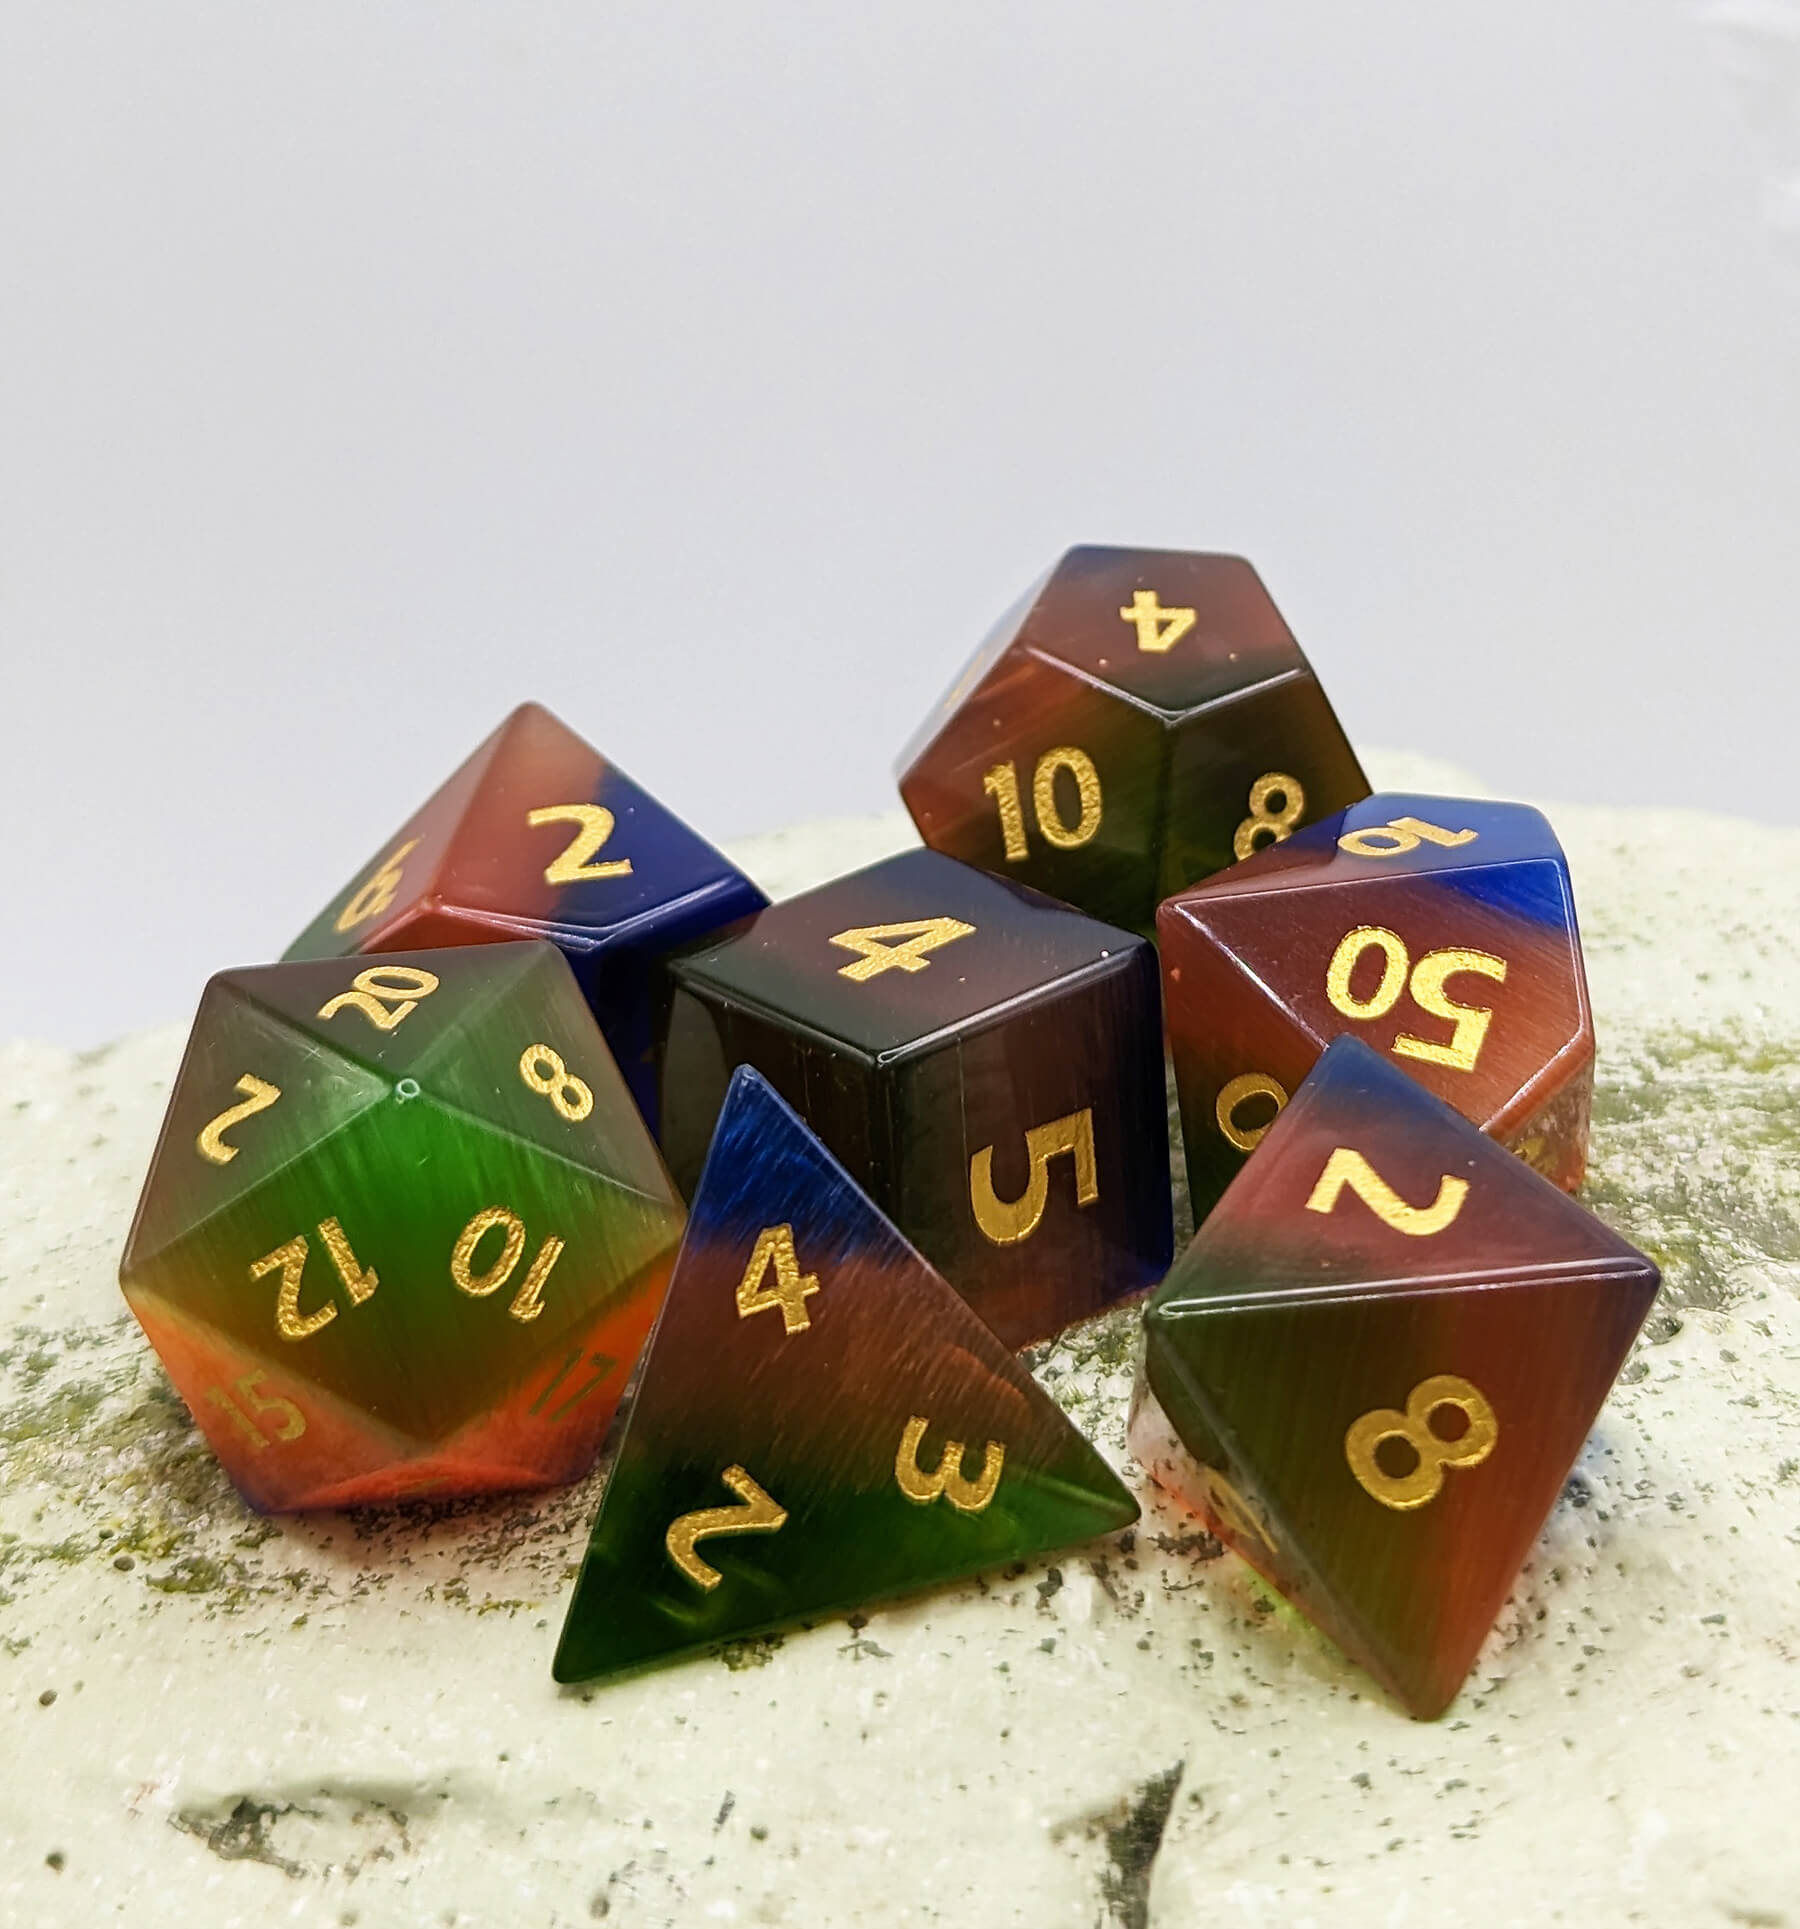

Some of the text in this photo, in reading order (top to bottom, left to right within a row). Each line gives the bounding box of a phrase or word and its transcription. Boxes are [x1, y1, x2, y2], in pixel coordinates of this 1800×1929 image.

[1119, 590, 1198, 654] 4
[526, 802, 634, 886] 2
[983, 746, 1102, 862] 10
[1233, 772, 1306, 862] 8
[1337, 816, 1479, 857] 10
[828, 916, 977, 983] 4
[316, 965, 440, 1031] 20
[1325, 925, 1508, 1074] 50
[197, 1072, 282, 1166] 2
[519, 1043, 595, 1123] 8
[969, 1107, 1099, 1246] 5
[1304, 1146, 1471, 1237] 2
[249, 1215, 380, 1340] 12
[450, 1204, 566, 1323] 10
[735, 1222, 821, 1336] 4
[204, 1368, 307, 1449] 15
[1345, 1374, 1499, 1511] 8
[894, 1414, 1006, 1513] 3
[665, 1463, 789, 1594] 2
